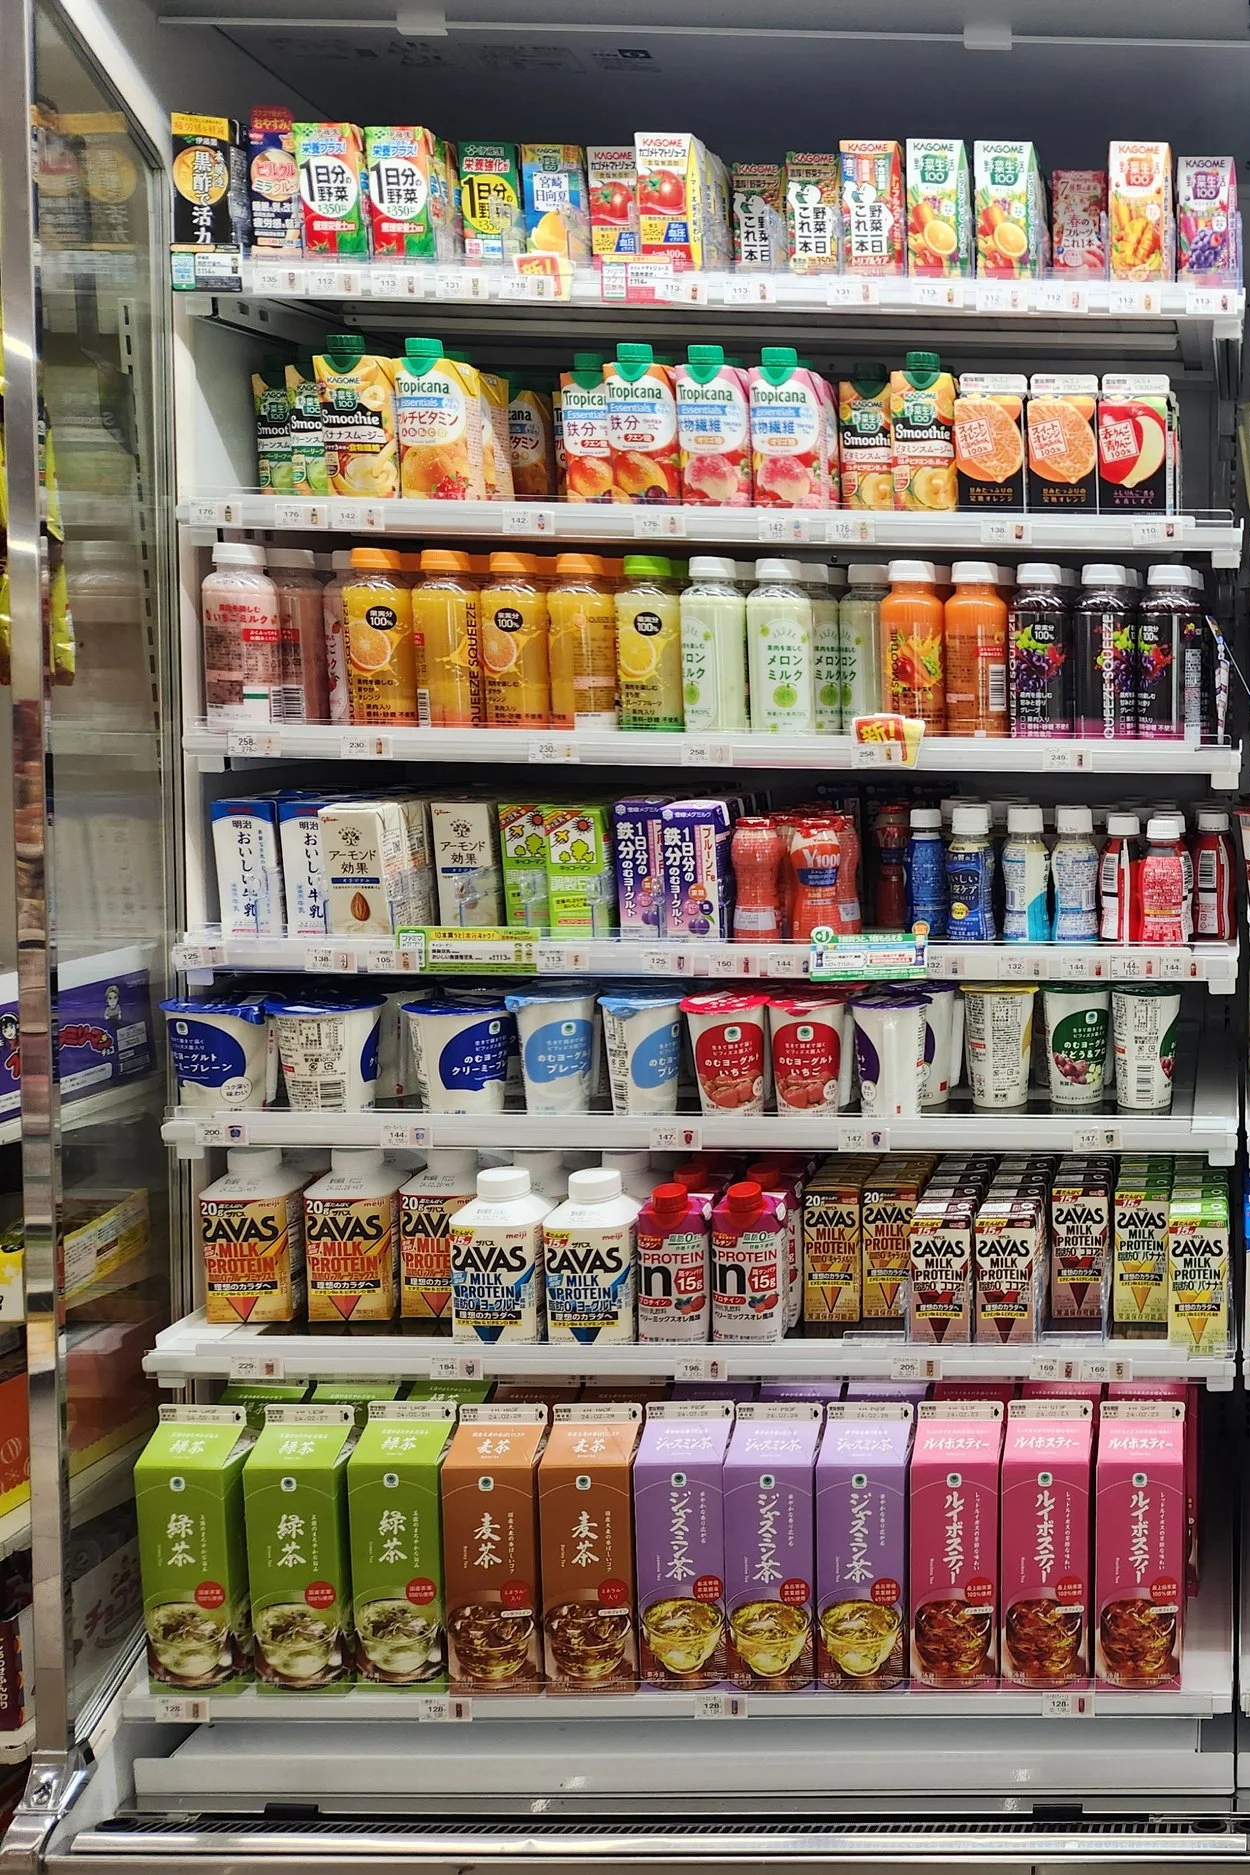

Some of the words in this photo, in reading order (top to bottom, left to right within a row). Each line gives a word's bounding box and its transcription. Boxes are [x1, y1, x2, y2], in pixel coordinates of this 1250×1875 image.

[642, 137, 684, 151] KAGOME
[913, 142, 954, 154] KAGOME
[982, 144, 1024, 156] KAGOME
[1117, 144, 1159, 157] KAGOME
[593, 151, 633, 163] KAGOME
[794, 153, 834, 165] KAGOME
[1184, 157, 1226, 170] KAGOME
[540, 178, 572, 193] 宮崎
[318, 187, 348, 204] 野菜
[388, 189, 419, 205] 野菜
[326, 375, 361, 387] KAGOME
[607, 386, 663, 408] Tropicana
[676, 388, 734, 410] Tropicana
[750, 389, 807, 411] Tropicana
[905, 391, 938, 402] KAGOME
[322, 412, 381, 432] Smoothie
[610, 413, 639, 432] 鉄分
[567, 421, 598, 441] 鉄分
[896, 424, 951, 441] Smoothie
[467, 601, 481, 672] SQUEEZE
[1007, 613, 1017, 675] SQUEEZE
[767, 652, 804, 666] メロン
[767, 666, 804, 680] ミルク
[232, 819, 253, 830] 明治
[299, 820, 319, 831] 明治
[439, 840, 486, 855] アーモンド
[329, 849, 378, 863] アーモンド
[450, 853, 479, 866] 効果
[340, 861, 370, 875] 効果
[719, 1065, 750, 1077] いちご
[791, 1065, 823, 1077] いちご
[258, 1199, 282, 1210] meiji
[805, 1209, 858, 1227] SAVAS
[1053, 1207, 1106, 1226] SAVAS
[203, 1214, 280, 1243] SAVAS
[307, 1213, 384, 1243] SAVAS
[817, 1226, 848, 1242] MILK
[219, 1241, 261, 1257] MILK
[324, 1241, 364, 1257] MILK
[912, 1240, 966, 1259] SAVAS
[977, 1240, 1031, 1259] SAVAS
[208, 1257, 276, 1273] PROTEIN
[312, 1257, 379, 1273] PROTEIN
[545, 1246, 621, 1274] SAVAS
[565, 1274, 601, 1287] MILK
[553, 1287, 611, 1301] PROTEIN
[166, 1512, 196, 1568] 緑茶
[276, 1512, 307, 1568] 緑茶
[377, 1509, 408, 1564] 緑茶
[472, 1511, 502, 1570] 麦茶
[570, 1510, 600, 1568] 麦茶
[666, 1490, 697, 1581] ジャスミン茶
[752, 1493, 784, 1584] ジャスミン茶
[942, 1490, 966, 1585] ルイボスティー
[1032, 1490, 1057, 1584] ルイボスティー
[1128, 1490, 1152, 1585] ルイボスティー
